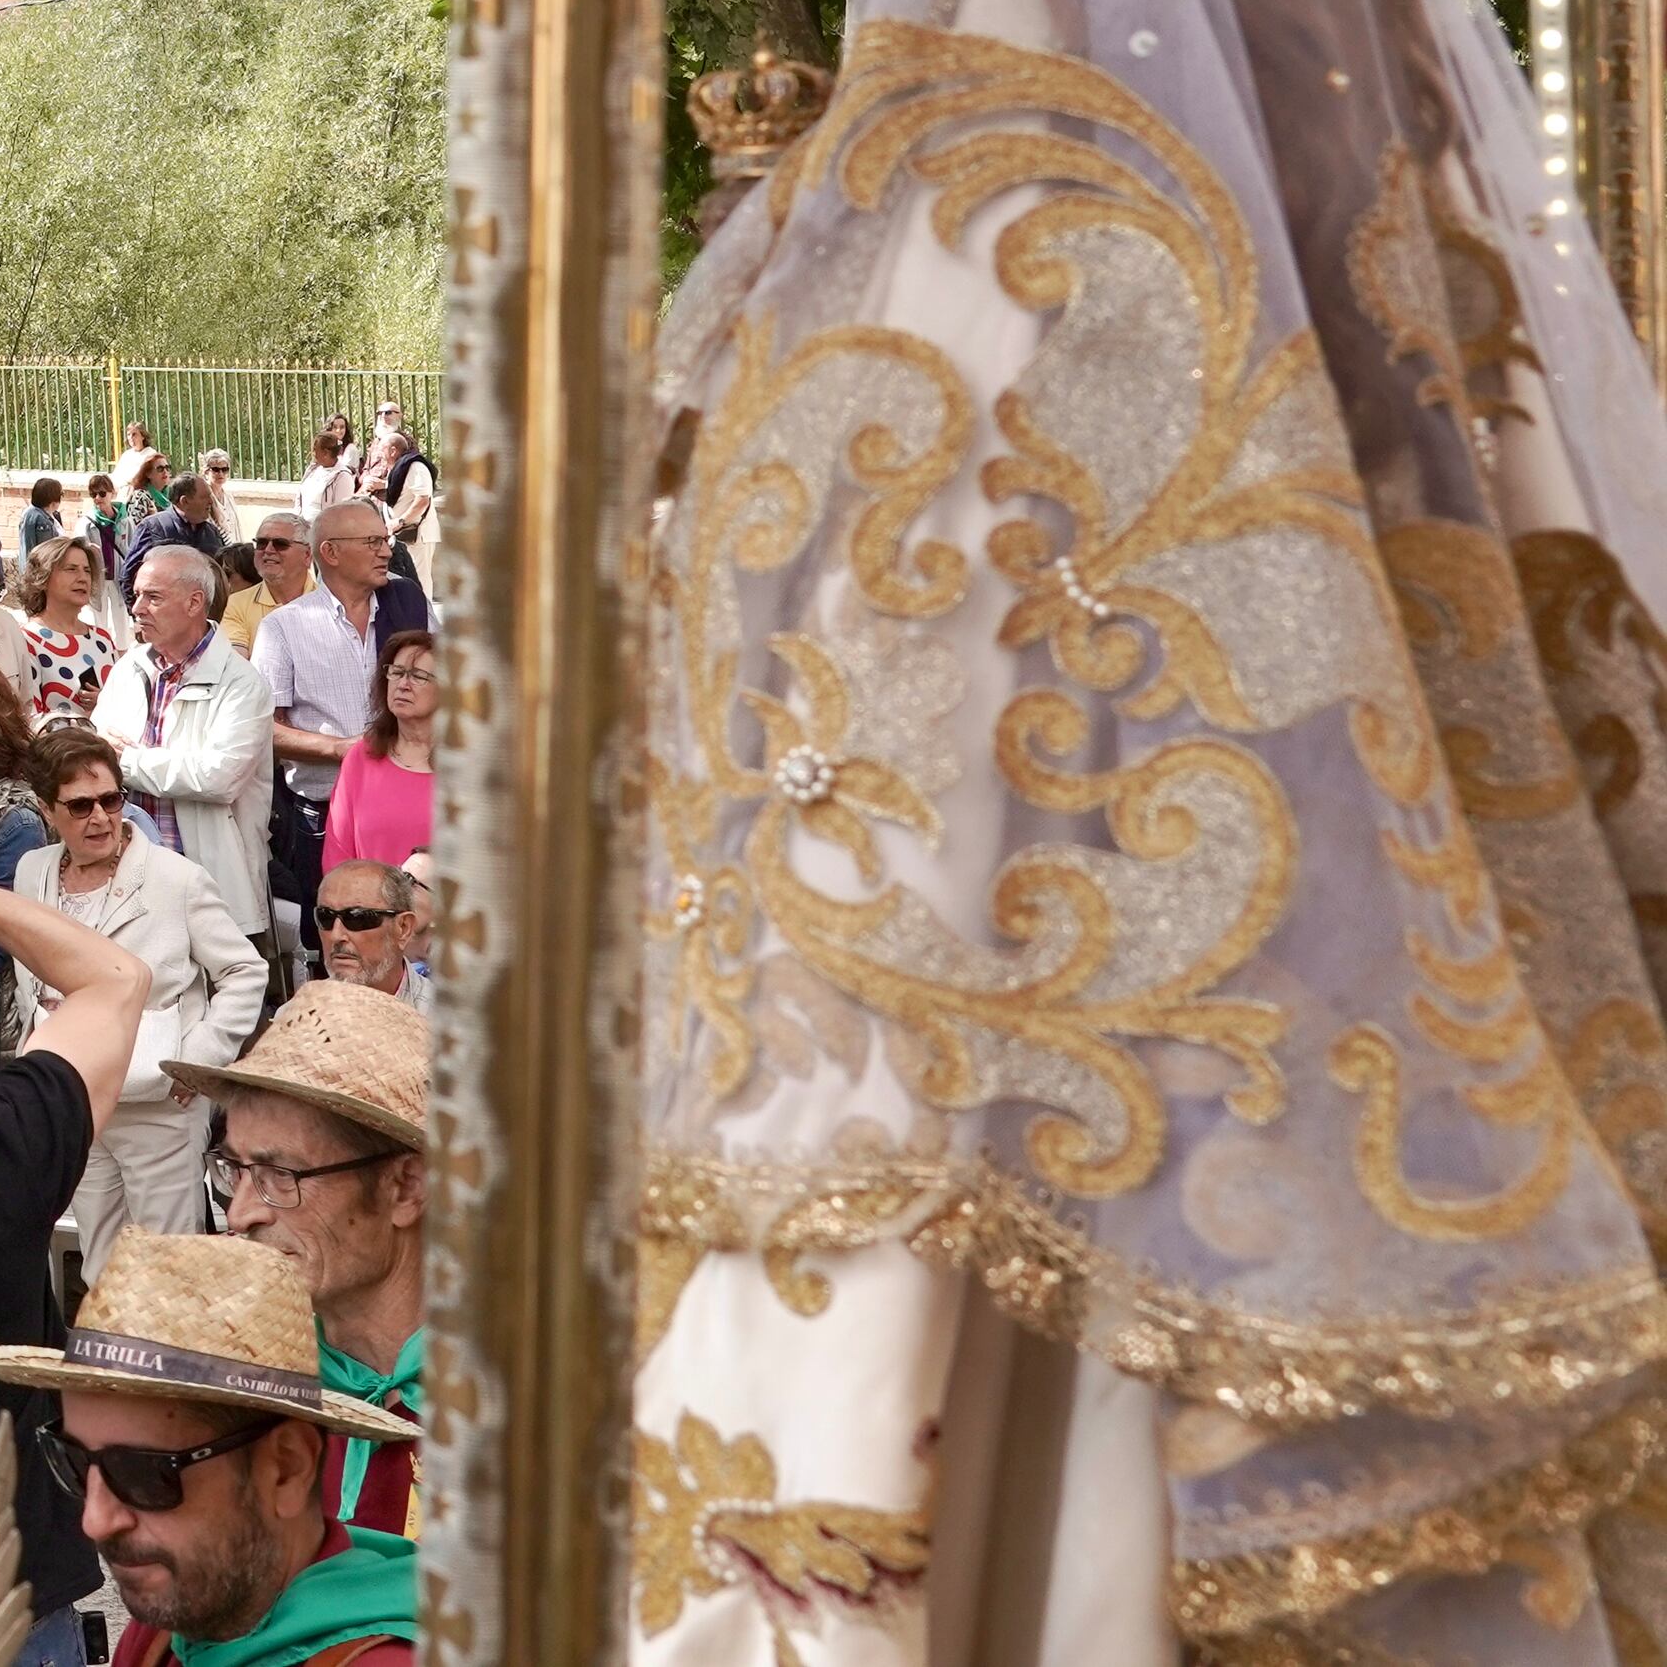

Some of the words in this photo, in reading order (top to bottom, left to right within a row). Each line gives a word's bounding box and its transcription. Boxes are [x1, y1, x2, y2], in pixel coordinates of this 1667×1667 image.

[74, 1338, 91, 1357] LA
[94, 1342, 164, 1371] TRILLA
[225, 1374, 288, 1395] CASTRILLO
